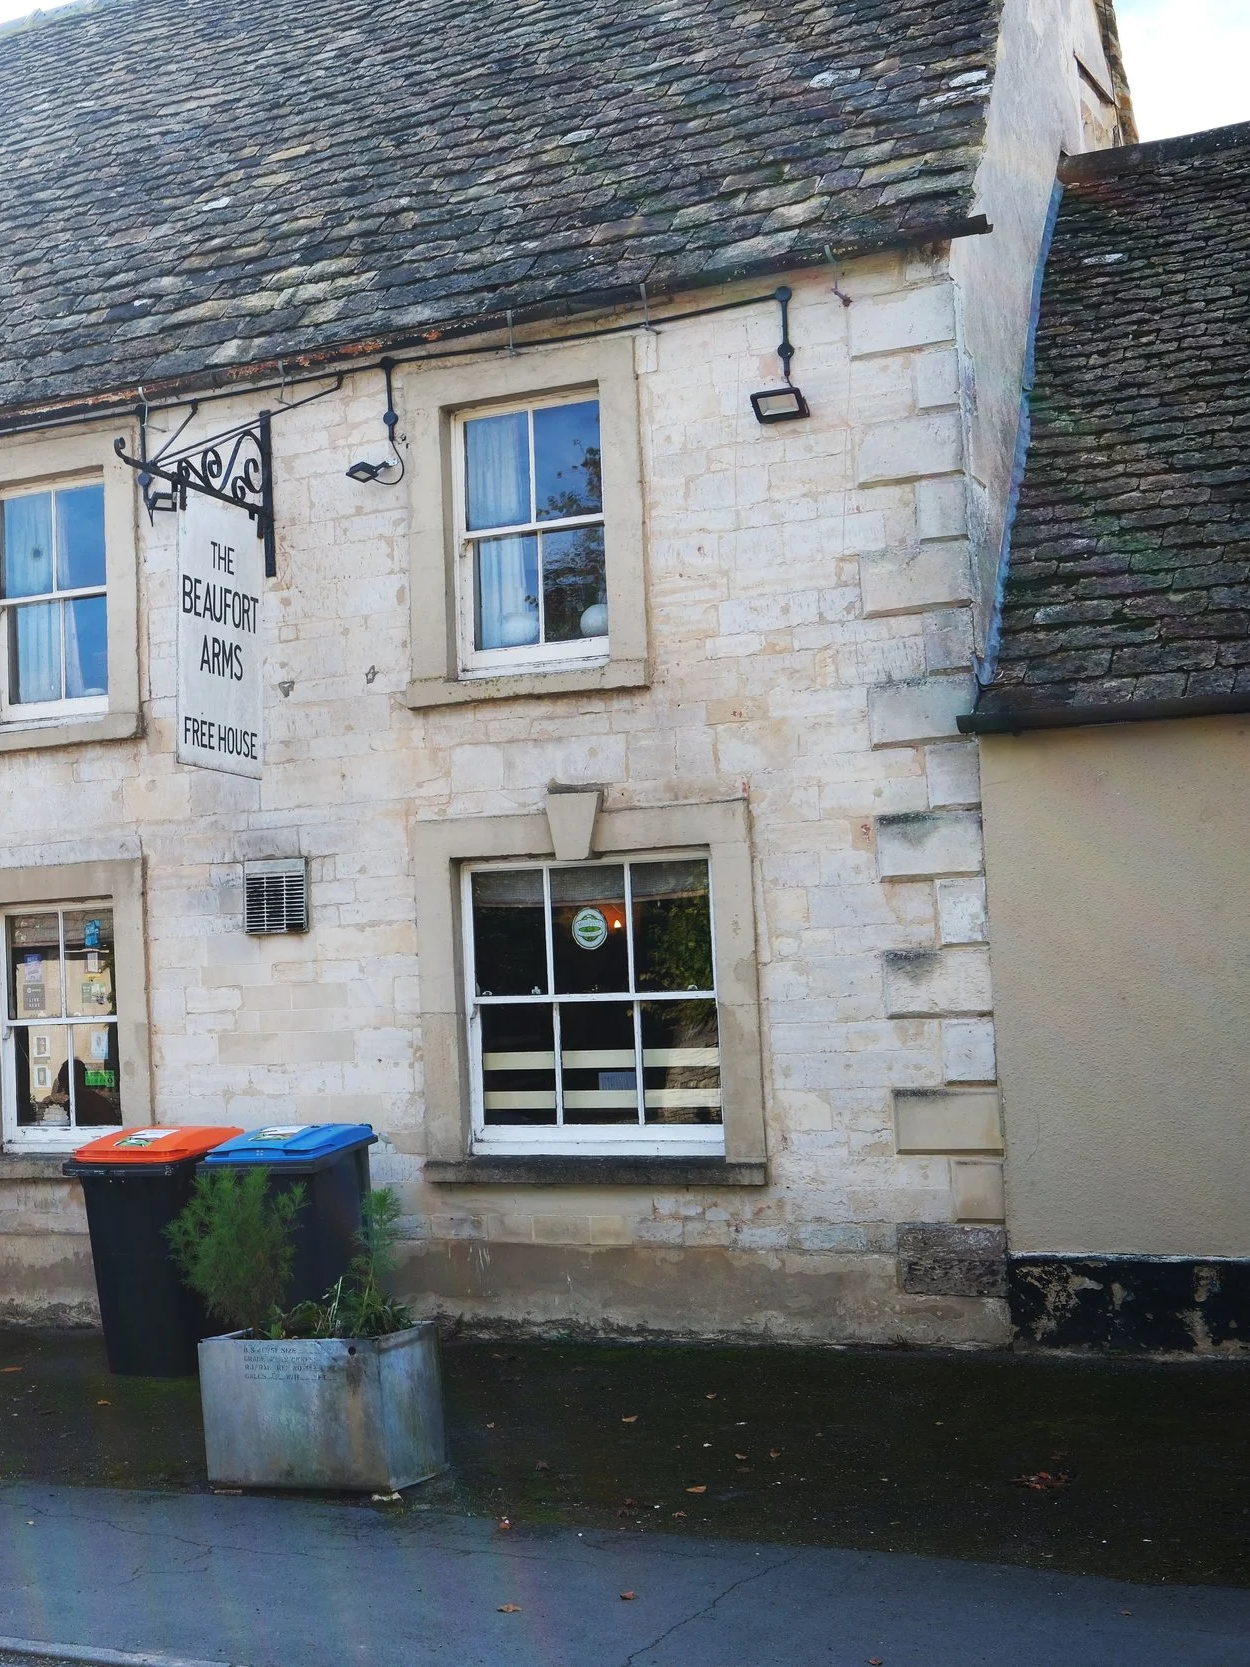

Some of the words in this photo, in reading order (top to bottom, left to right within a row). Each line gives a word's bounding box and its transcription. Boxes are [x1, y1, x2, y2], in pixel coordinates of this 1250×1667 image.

[210, 540, 235, 576] THE
[182, 573, 259, 634] BEAUFORT
[199, 634, 243, 681] ARMS
[184, 716, 215, 750] FREE
[218, 724, 258, 760] HOUSE
